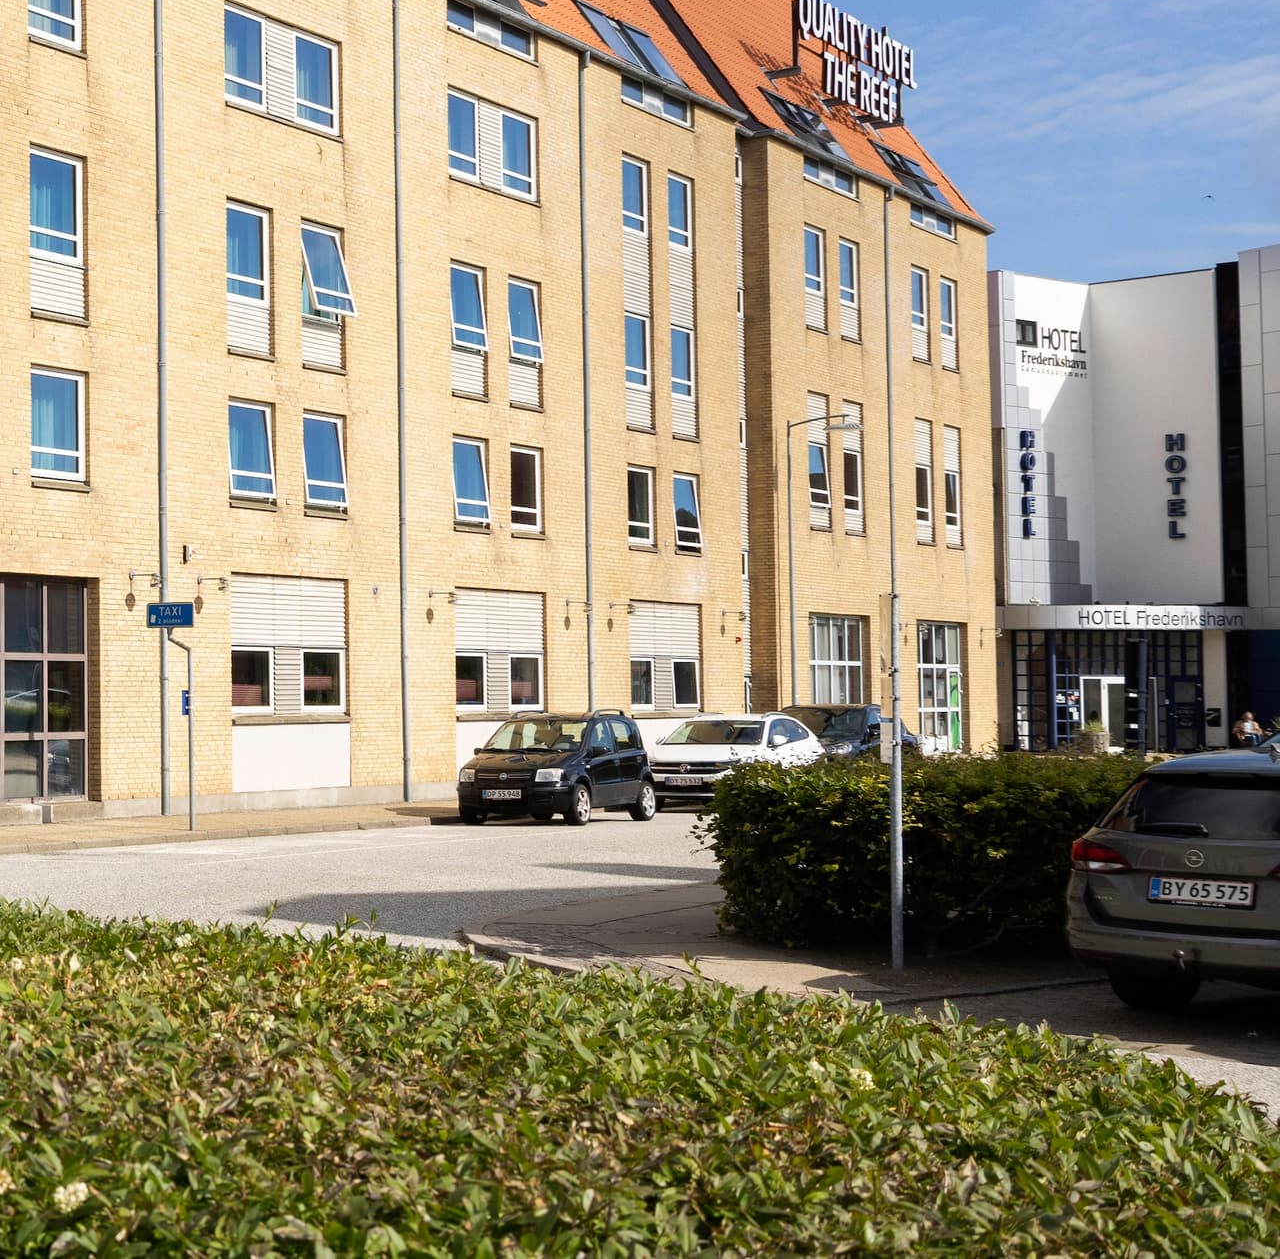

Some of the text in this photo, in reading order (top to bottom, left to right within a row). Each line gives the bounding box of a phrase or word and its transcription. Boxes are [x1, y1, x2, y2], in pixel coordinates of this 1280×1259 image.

[870, 27, 918, 89] HOTEL
[824, 51, 898, 123] THE REEF
[1041, 326, 1087, 354] HOTEL
[1021, 349, 1087, 370] Frederikshavn
[1019, 430, 1037, 539] HOTEL
[1165, 433, 1187, 539] HOTEL
[159, 606, 182, 616] TAXI
[1078, 610, 1244, 626] HOTEL Frederikshavn
[1162, 881, 1249, 901] BY 65 575
